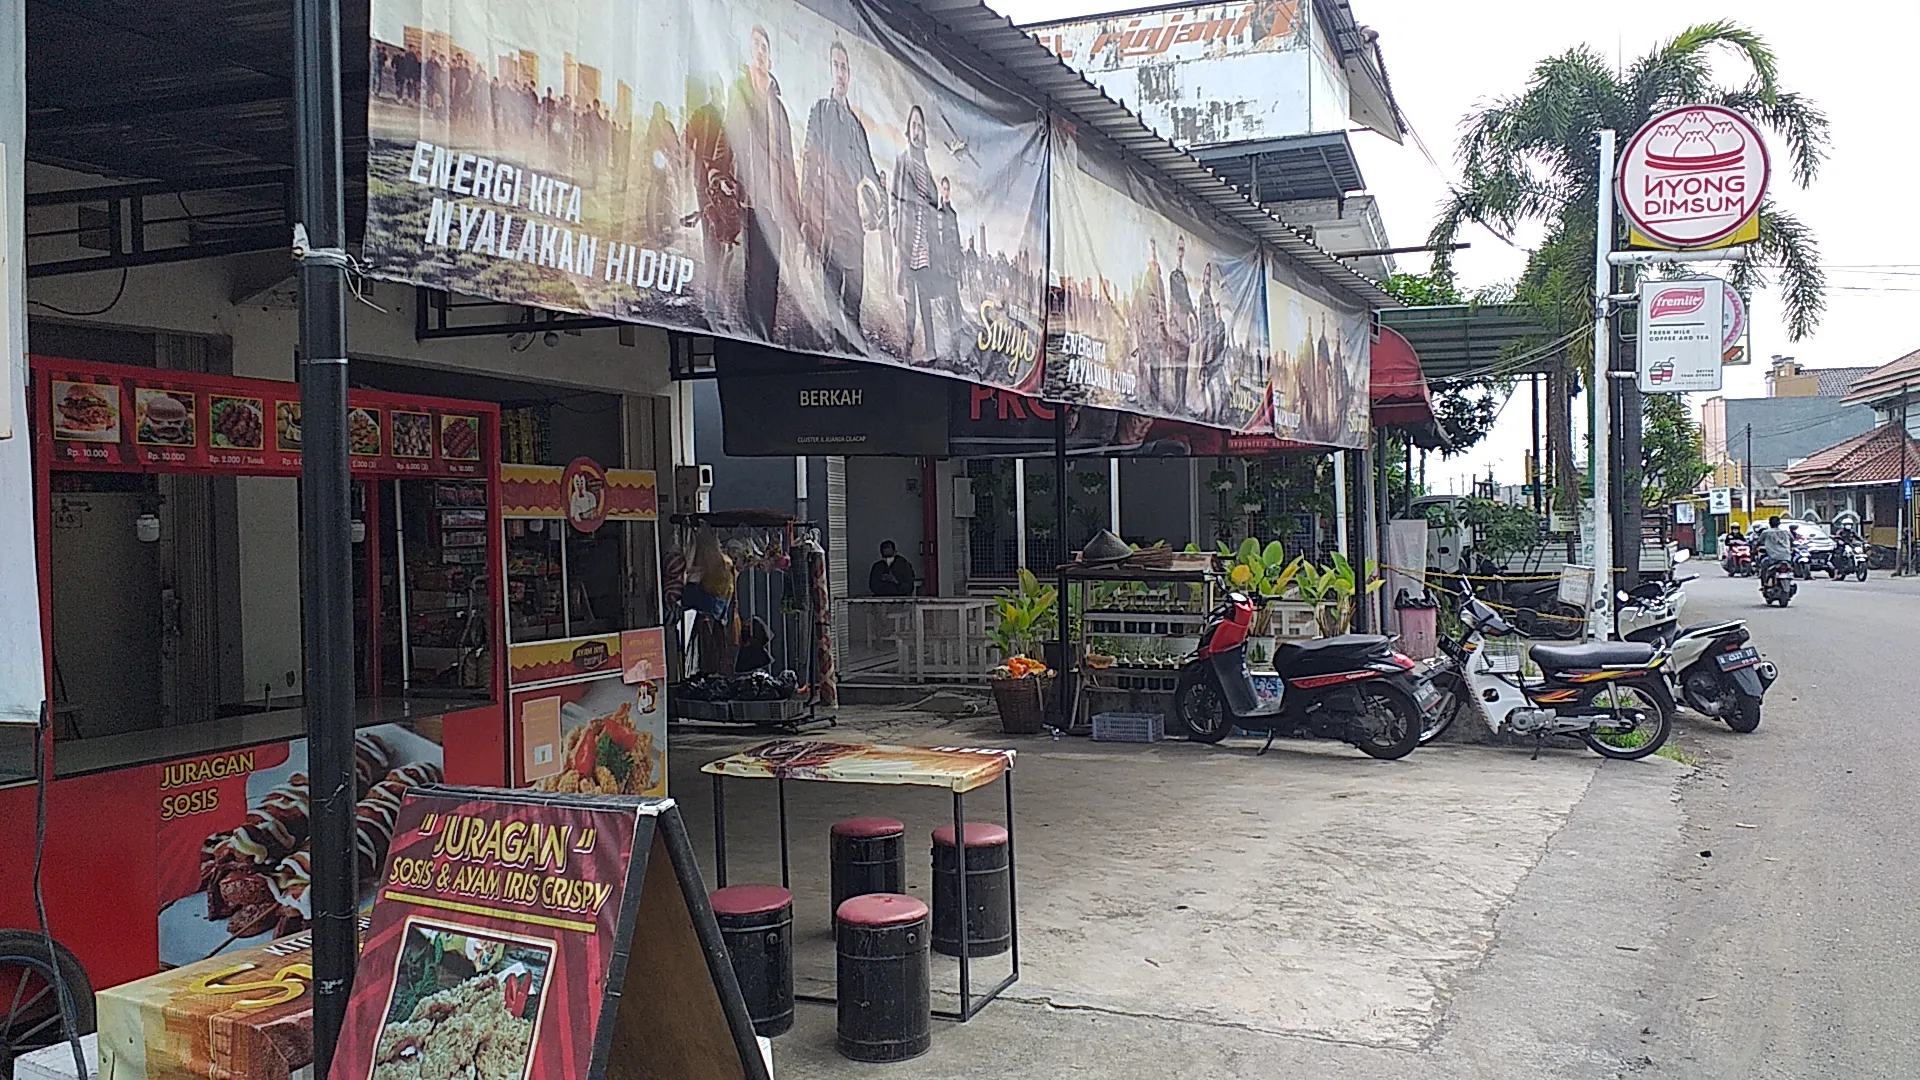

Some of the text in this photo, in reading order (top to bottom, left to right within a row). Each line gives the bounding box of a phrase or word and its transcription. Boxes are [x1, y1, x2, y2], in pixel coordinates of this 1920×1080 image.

[409, 141, 583, 224] ENERGI KITA
[1644, 196, 1746, 217] DIMSUM
[425, 198, 694, 295] NYALAKAN HIDUP
[978, 300, 1036, 377] Surya
[800, 389, 863, 406] BERKAH
[67, 448, 108, 458] Rp. 10.000
[148, 452, 186, 461] Rp. 10.000
[209, 455, 220, 464] Rp.
[161, 752, 254, 789] JURAGAN
[161, 788, 218, 819] SOSIS
[389, 856, 613, 915] SOSIS & AYAM IRIS CRISPY
